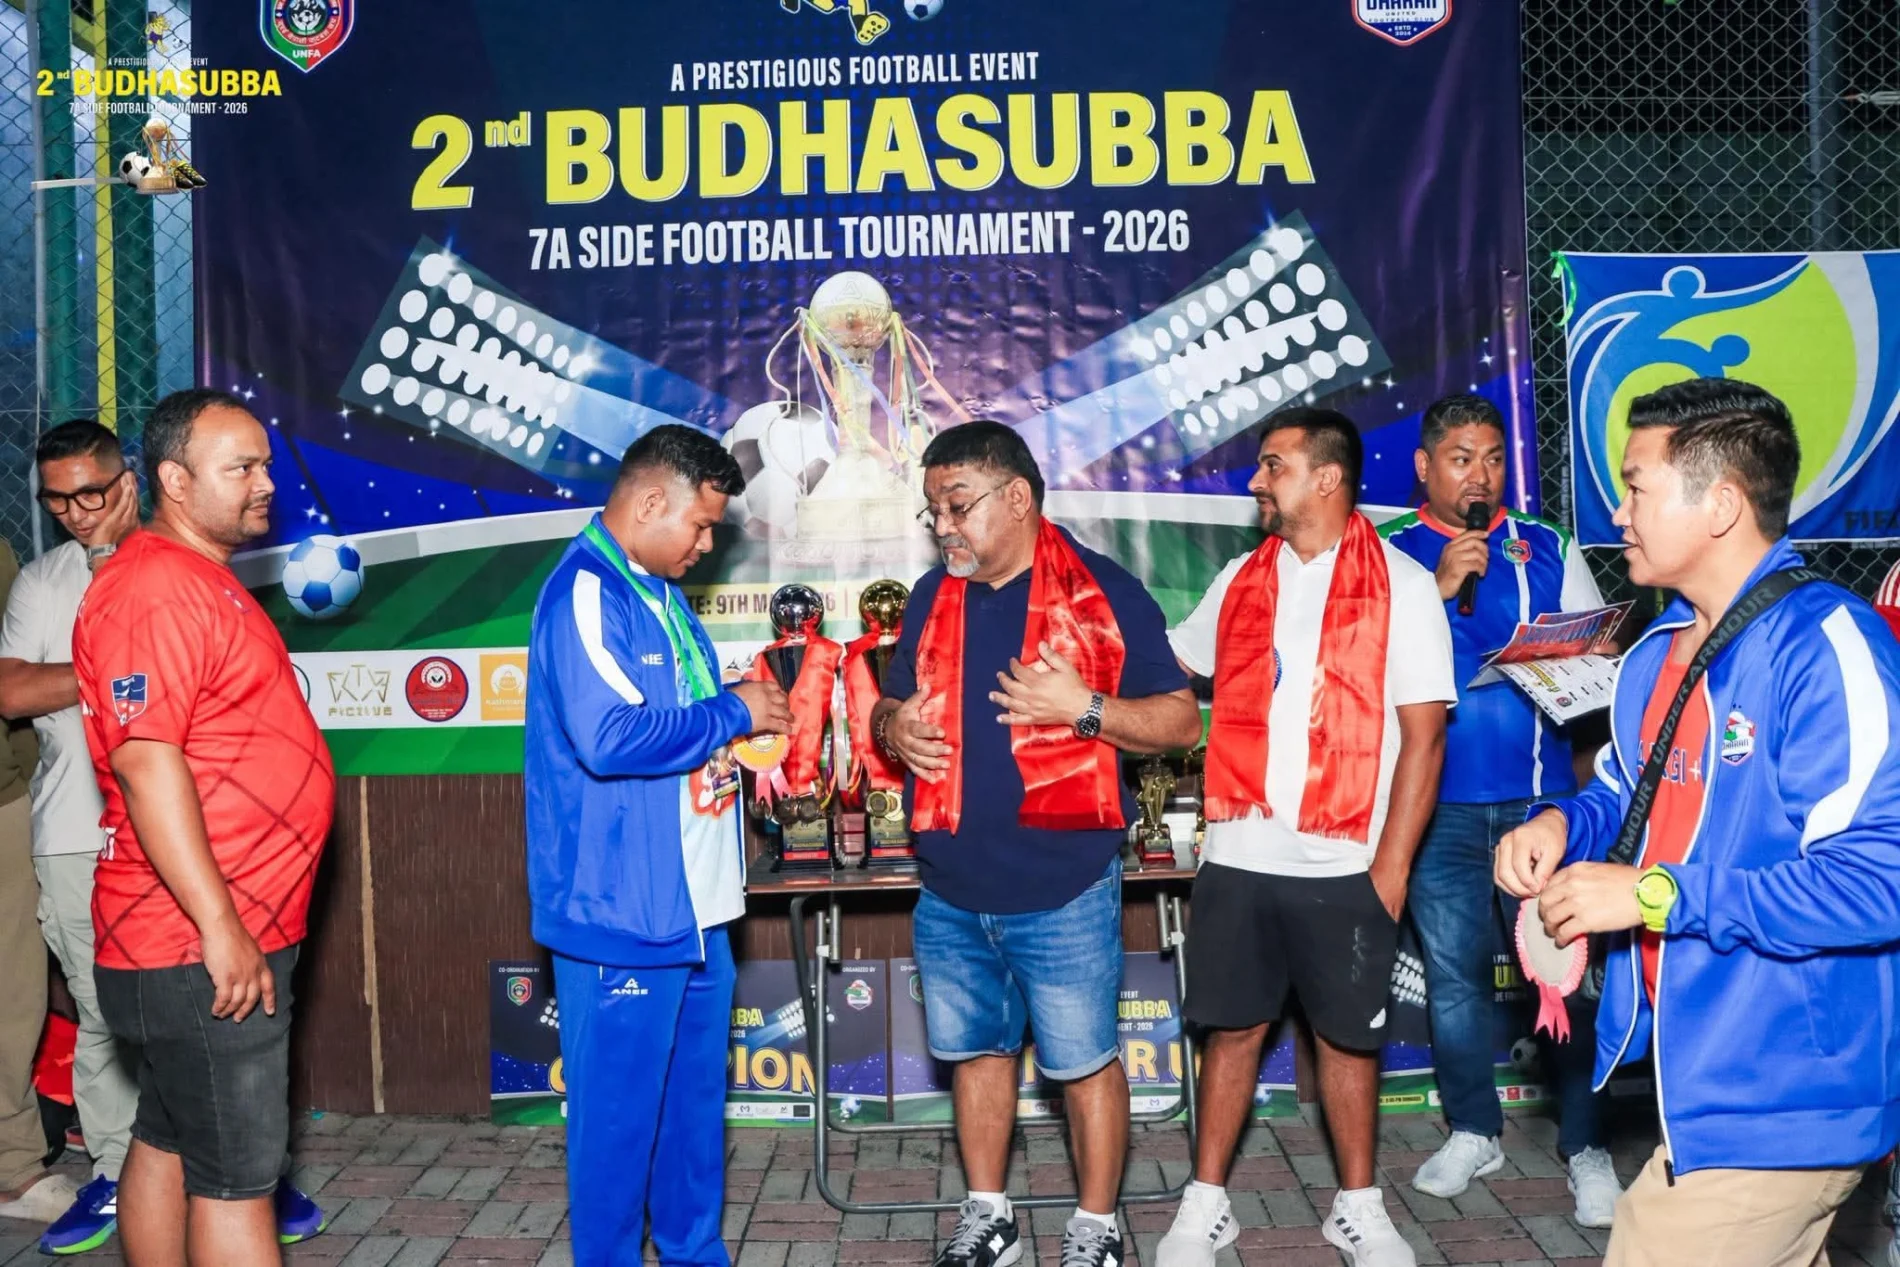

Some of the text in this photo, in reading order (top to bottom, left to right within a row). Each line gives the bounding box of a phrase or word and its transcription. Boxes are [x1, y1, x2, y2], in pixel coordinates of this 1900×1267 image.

[292, 49, 322, 58] UNFA
[670, 51, 1039, 92] A PRESTIGIOUS FOOTBALL EVENT
[411, 90, 1316, 211] 2nd BUDHASUBBA
[529, 228, 572, 270] 7A
[579, 224, 654, 269] SIDE
[663, 217, 833, 265] FOOTBALL
[838, 210, 1075, 259] TOURNAMENT
[1103, 209, 1190, 253] 2026
[716, 594, 748, 614] 9TH
[1652, 586, 1776, 765] UNDER ARMOUR
